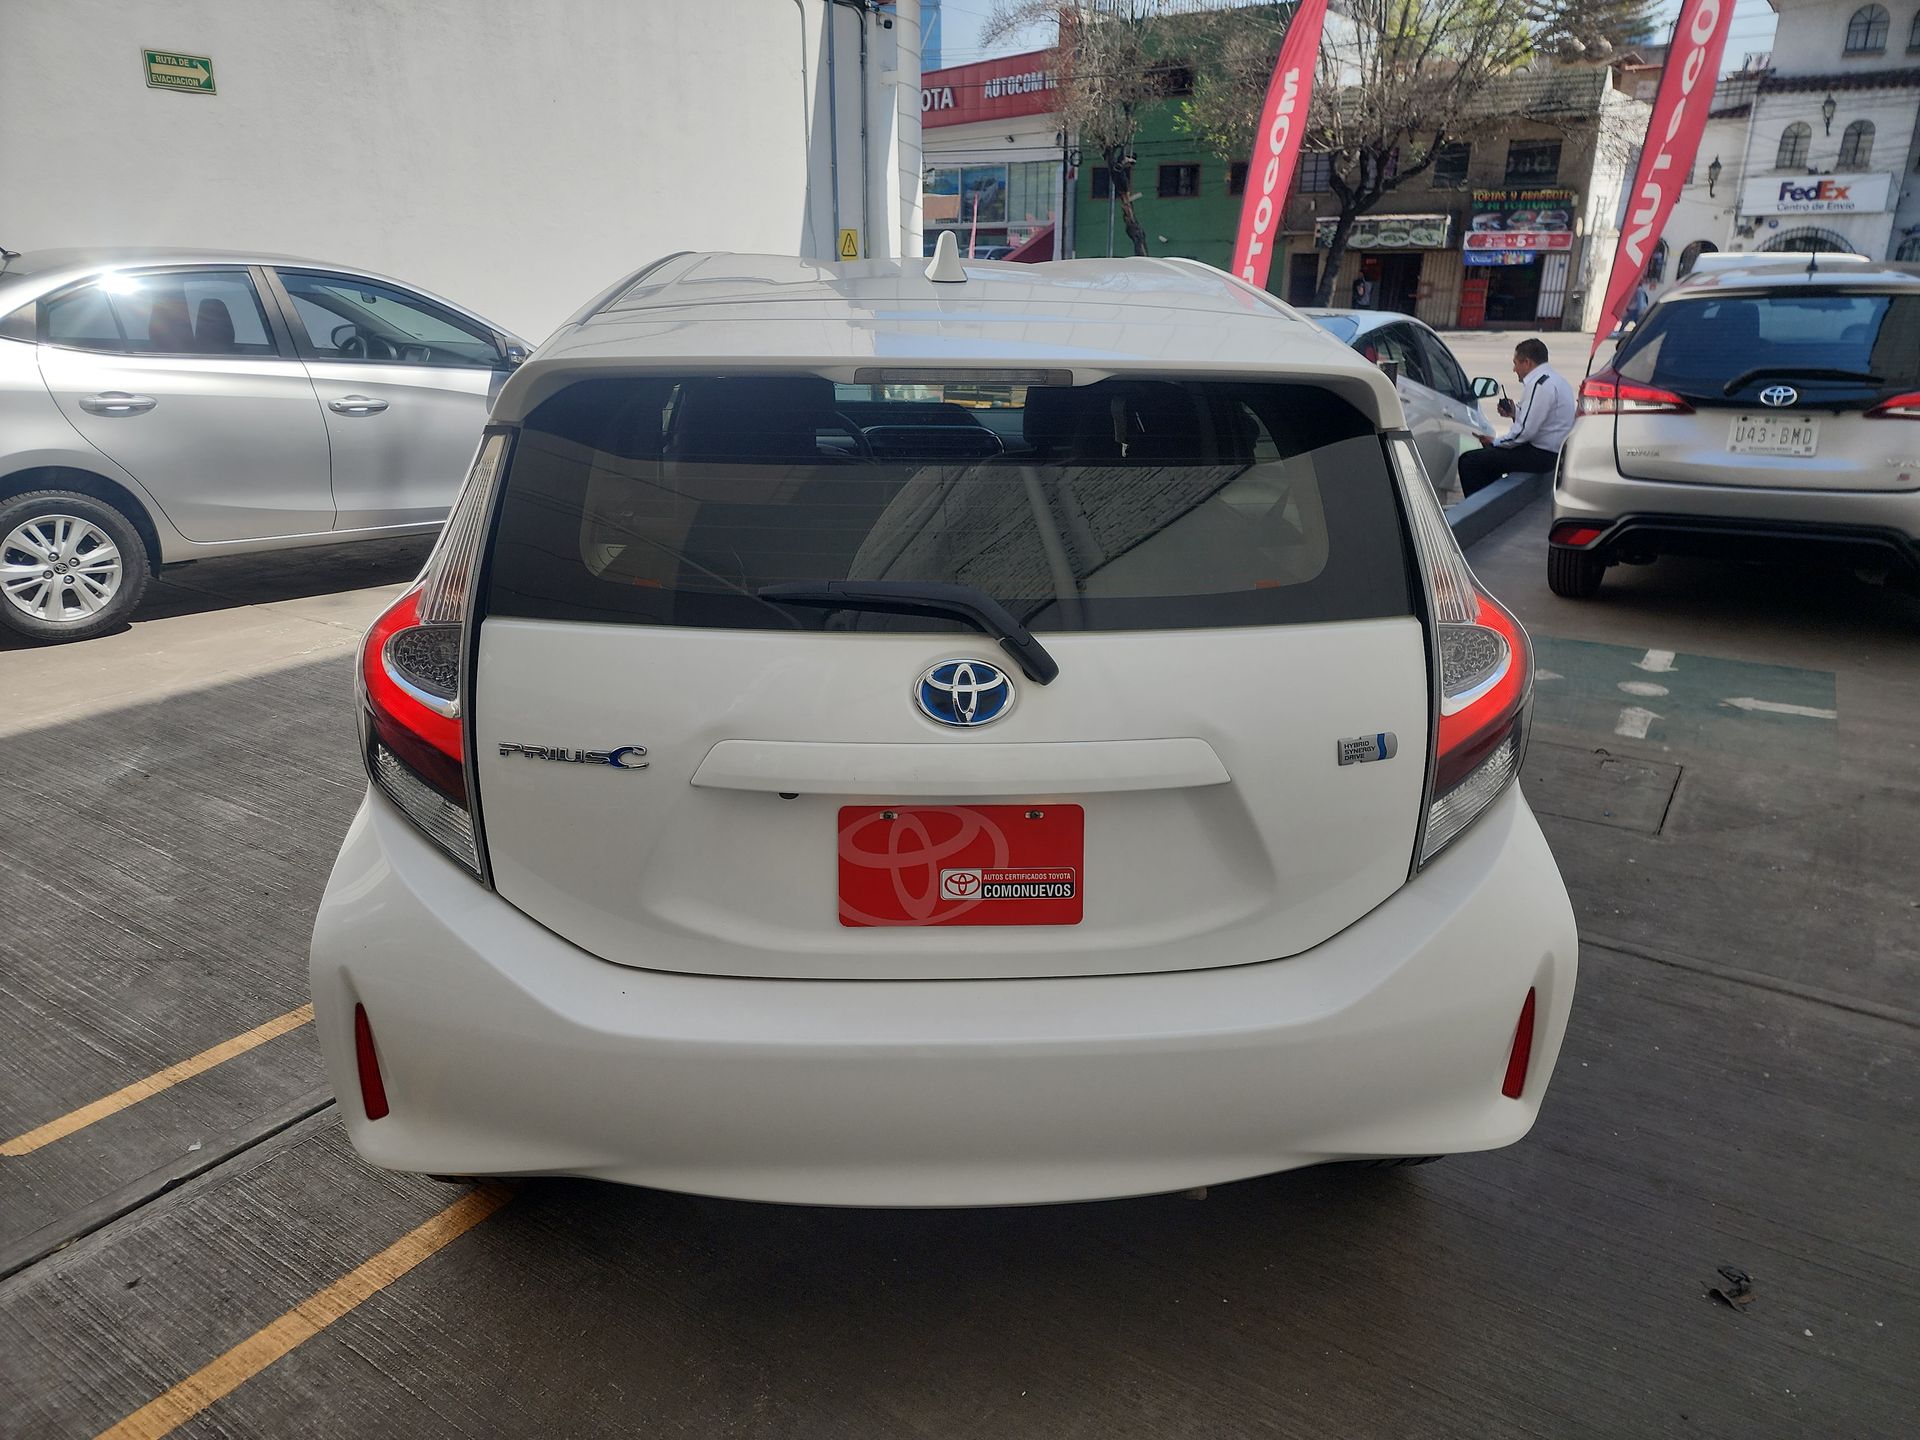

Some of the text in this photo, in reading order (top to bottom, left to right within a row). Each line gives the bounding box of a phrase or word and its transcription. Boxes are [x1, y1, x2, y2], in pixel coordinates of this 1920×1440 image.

[155, 55, 190, 67] RUTA DE
[152, 73, 199, 87] EVACUACION
[984, 72, 1044, 98] AUTOCOM
[1778, 180, 1851, 202] FedEx
[1777, 203, 1809, 212] Centro
[1811, 202, 1825, 211] de
[1344, 740, 1370, 749] HYBRID
[1344, 746, 1376, 755] SYNERGY
[1344, 753, 1365, 761] DRIVE
[983, 872, 1071, 881] AUTOS CERTIFICADOS TOYOTA
[983, 884, 1072, 898] COMONUEVOS
